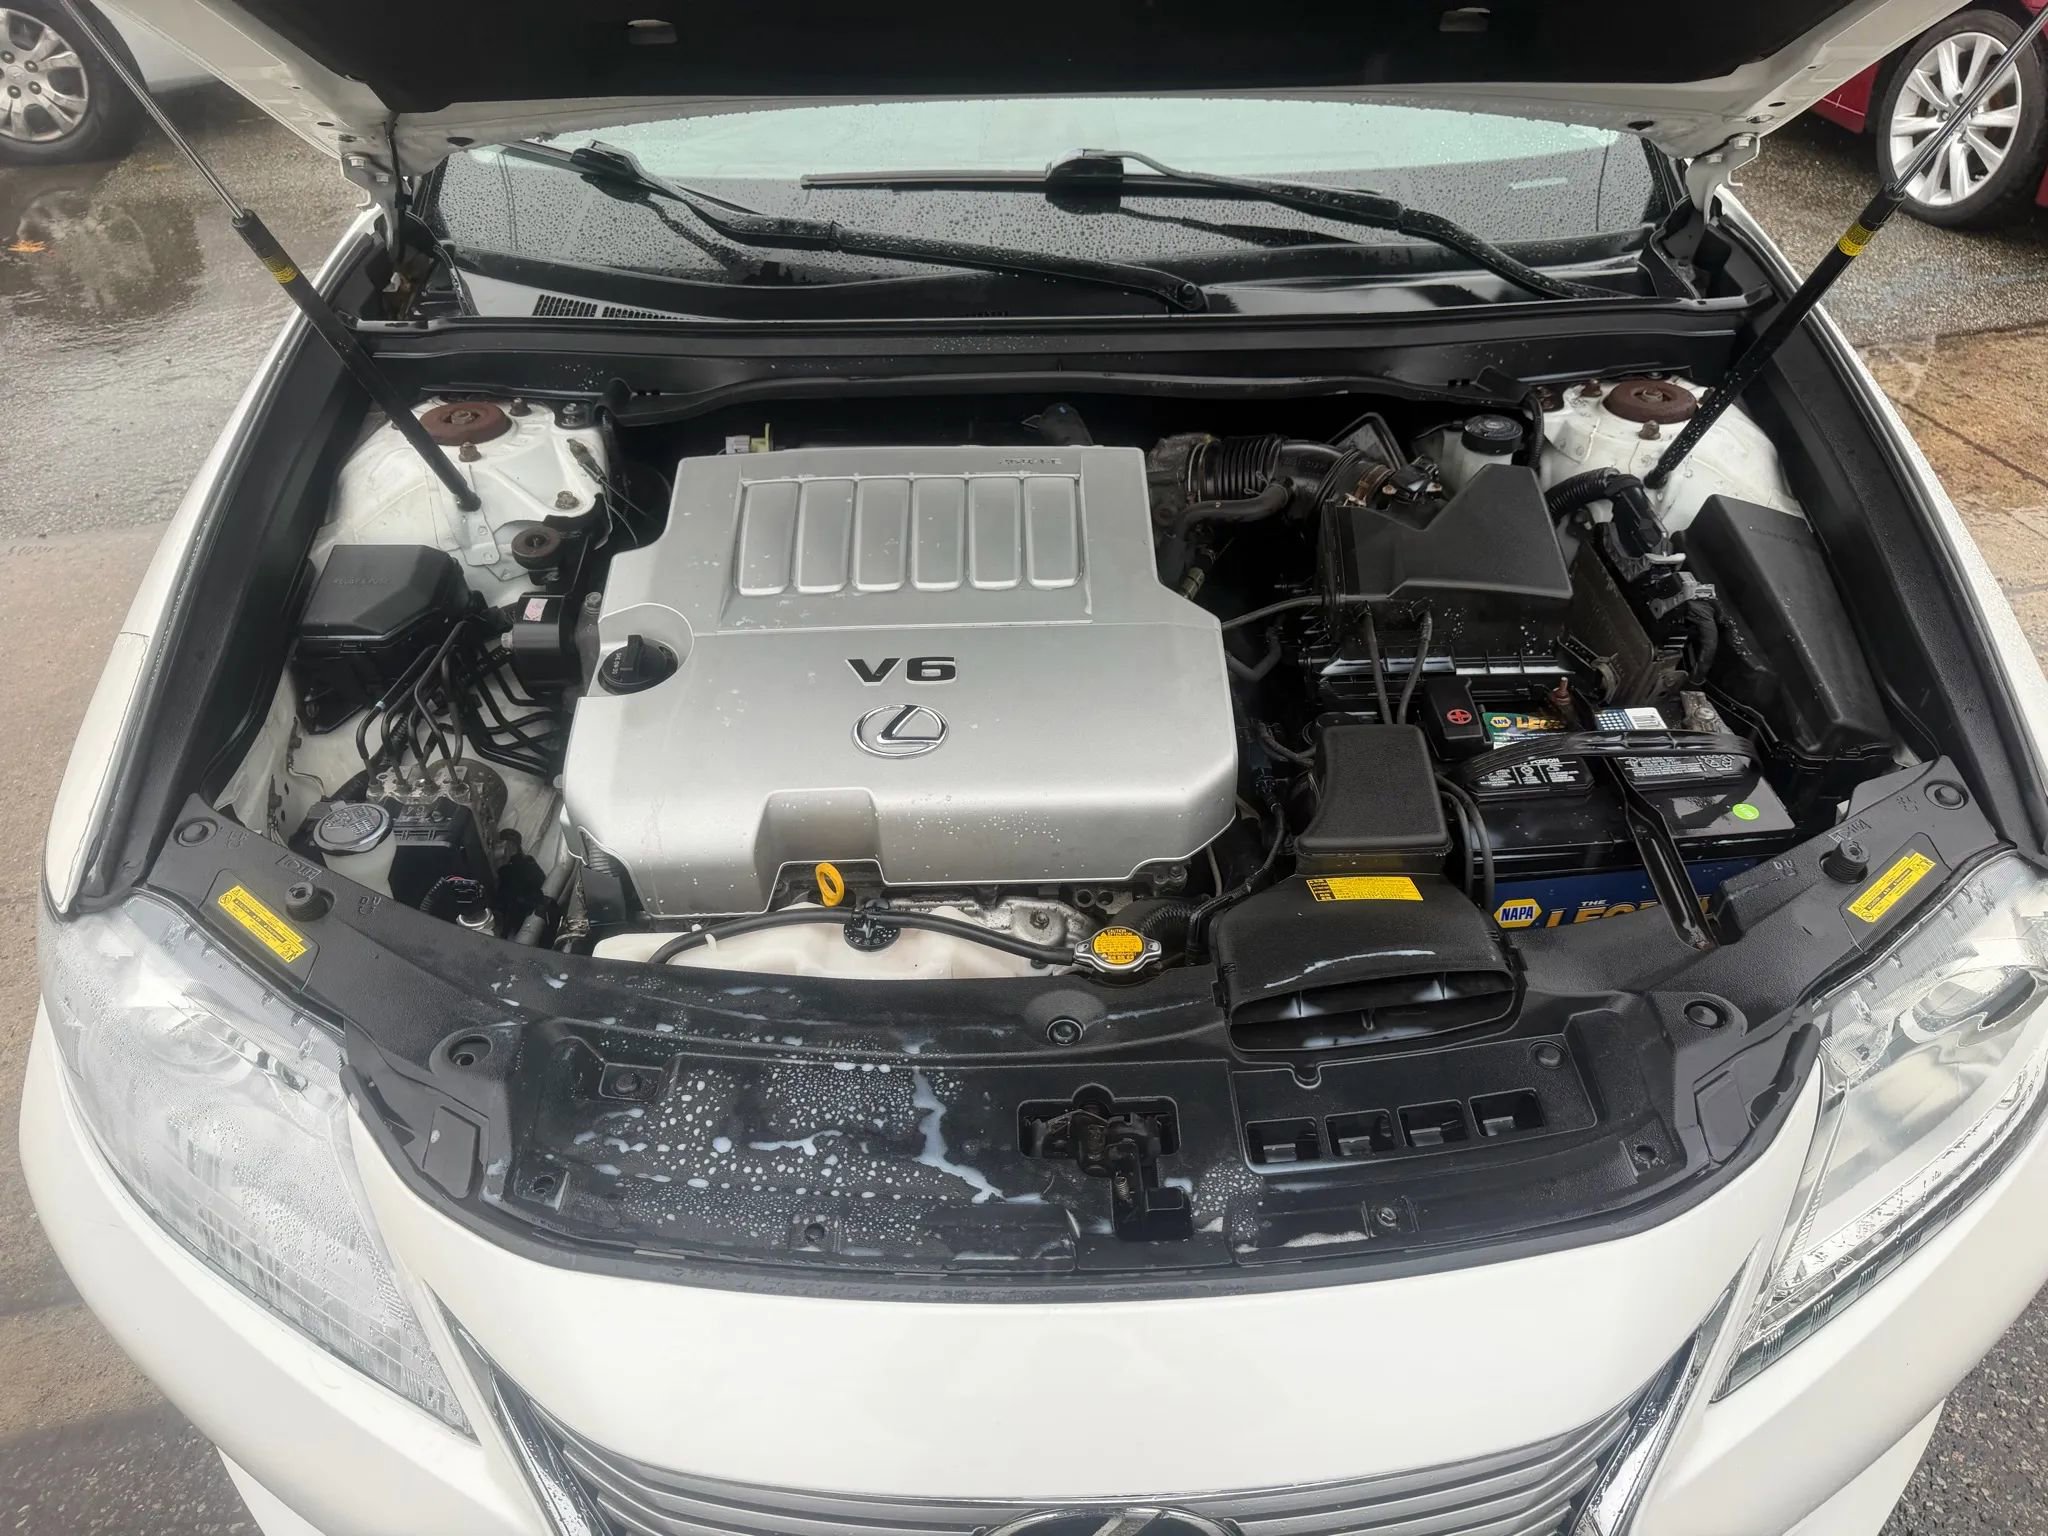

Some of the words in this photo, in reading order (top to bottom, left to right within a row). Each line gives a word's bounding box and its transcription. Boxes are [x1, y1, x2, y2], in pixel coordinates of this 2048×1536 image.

[846, 656, 956, 686] V6
[1580, 899, 1607, 908] THE
[1501, 906, 1534, 922] NAPA
